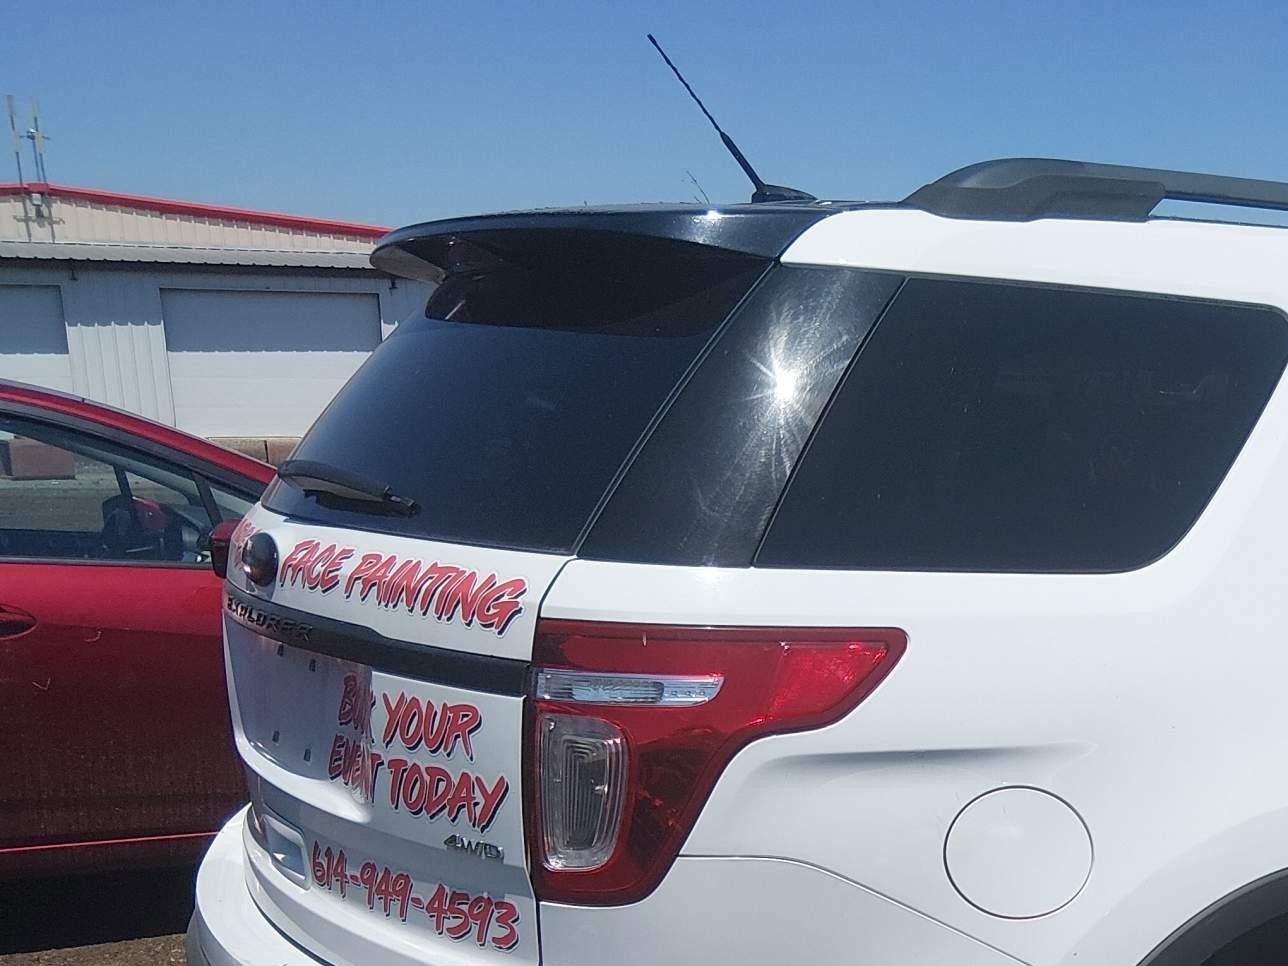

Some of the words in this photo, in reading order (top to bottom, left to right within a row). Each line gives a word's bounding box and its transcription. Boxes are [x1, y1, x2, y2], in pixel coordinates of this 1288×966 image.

[226, 596, 313, 641] EXPLORER
[280, 539, 354, 595] FACE
[344, 553, 527, 636] PAINTING
[382, 691, 483, 762] YOUR
[387, 758, 509, 834] TODAY
[312, 840, 520, 950] 614-949-4593
